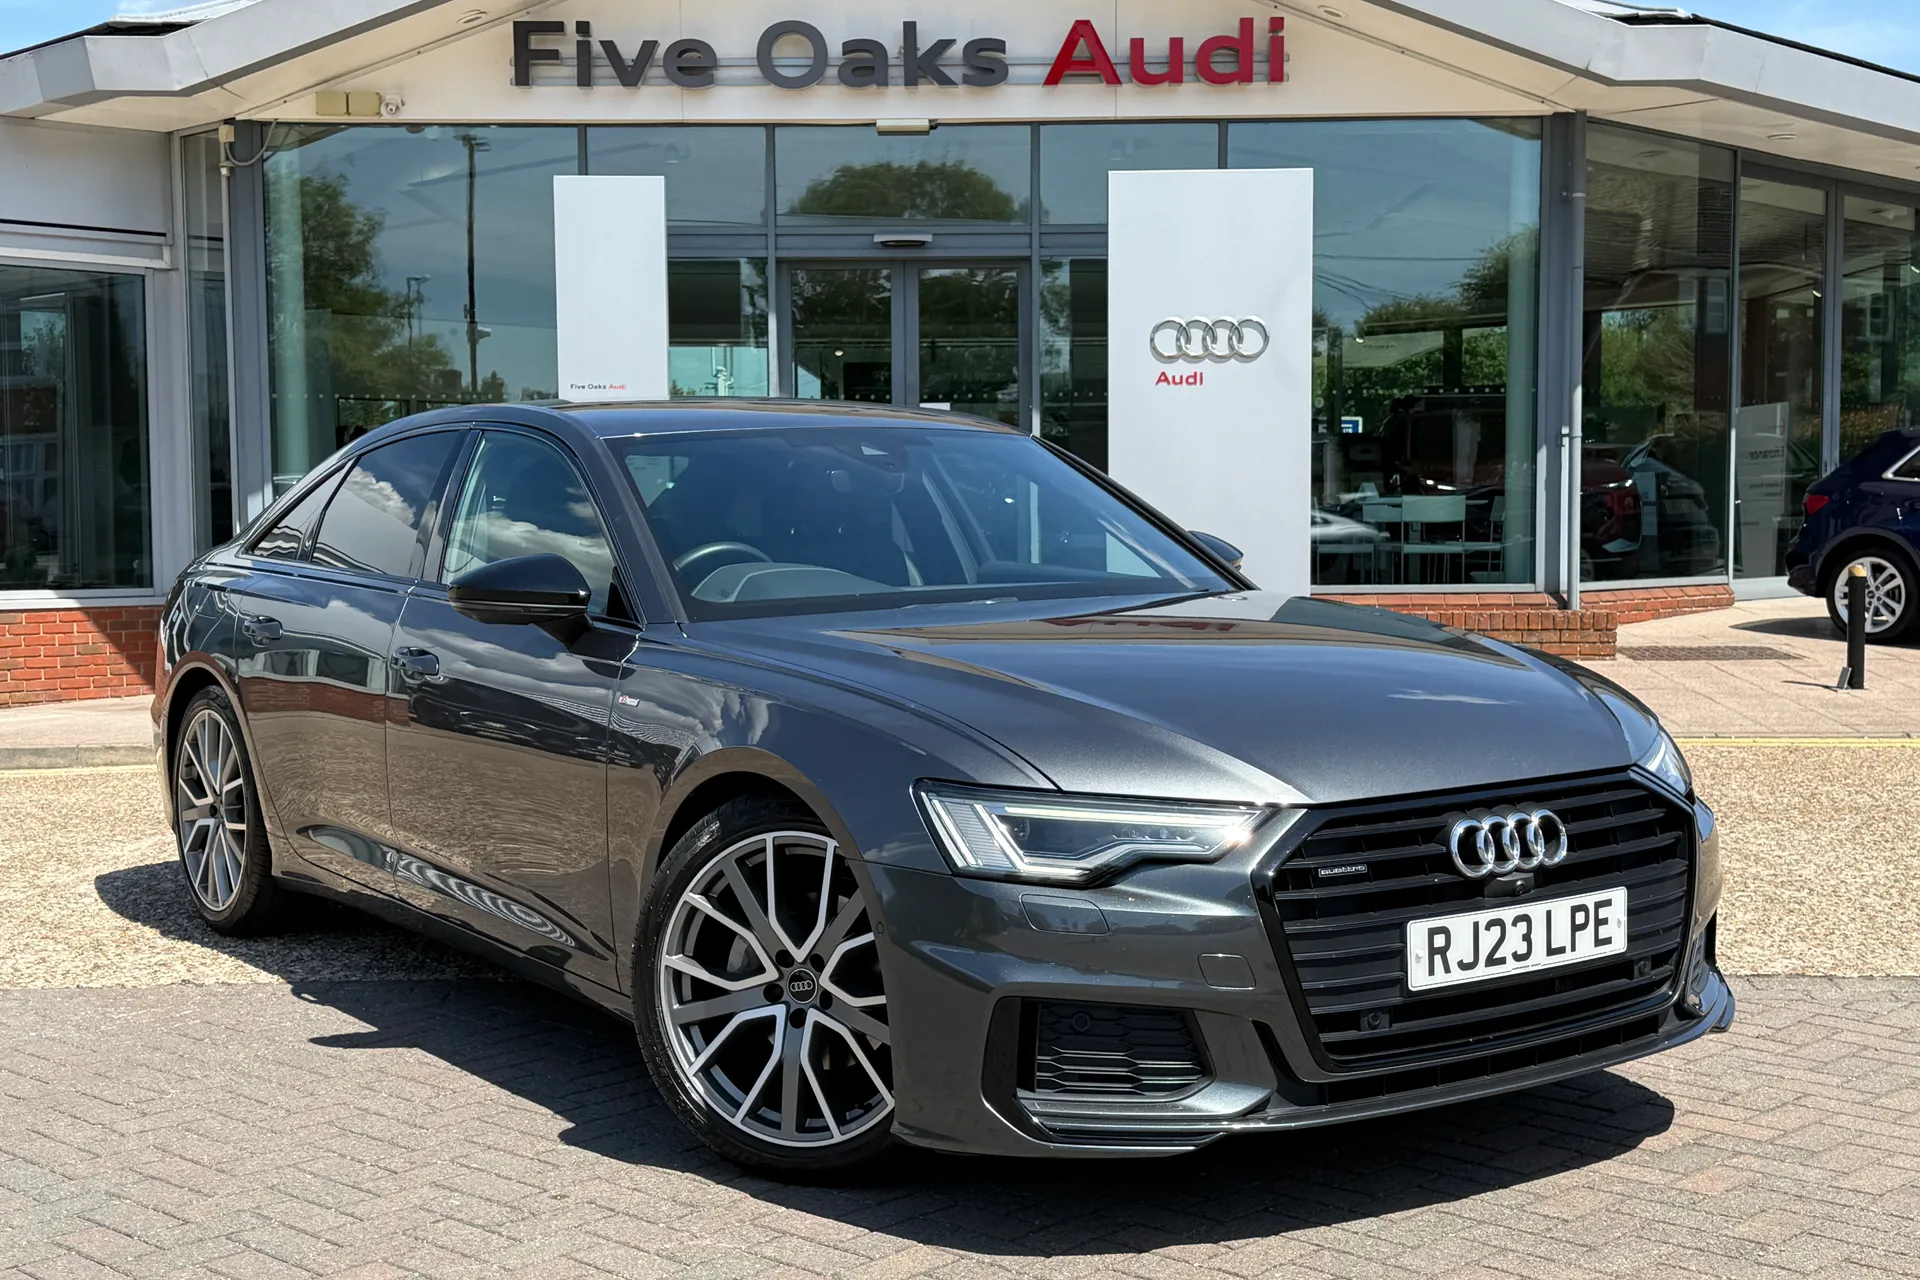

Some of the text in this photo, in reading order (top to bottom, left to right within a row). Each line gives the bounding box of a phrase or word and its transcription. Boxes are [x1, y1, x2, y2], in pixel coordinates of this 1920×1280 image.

[513, 17, 1285, 90] Five Oaks Audi
[1155, 371, 1203, 386] Audi
[1427, 898, 1613, 976] RJ23 LPE
